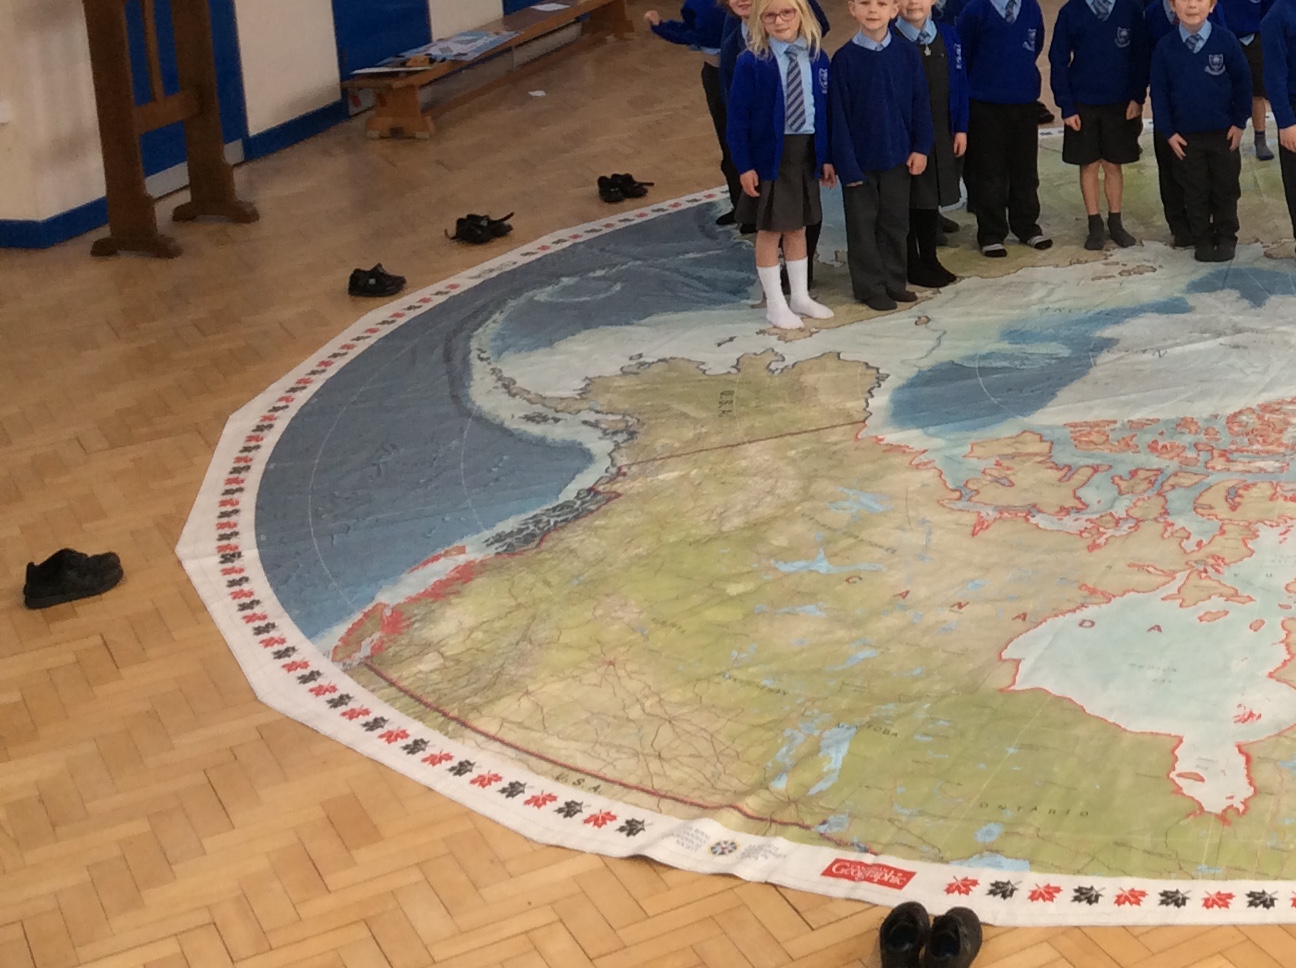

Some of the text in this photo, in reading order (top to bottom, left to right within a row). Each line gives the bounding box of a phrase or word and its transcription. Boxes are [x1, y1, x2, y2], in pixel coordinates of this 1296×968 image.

[843, 574, 1164, 635] CANADA
[978, 800, 1090, 818] ONTARIO
[831, 861, 907, 887] Geographic
